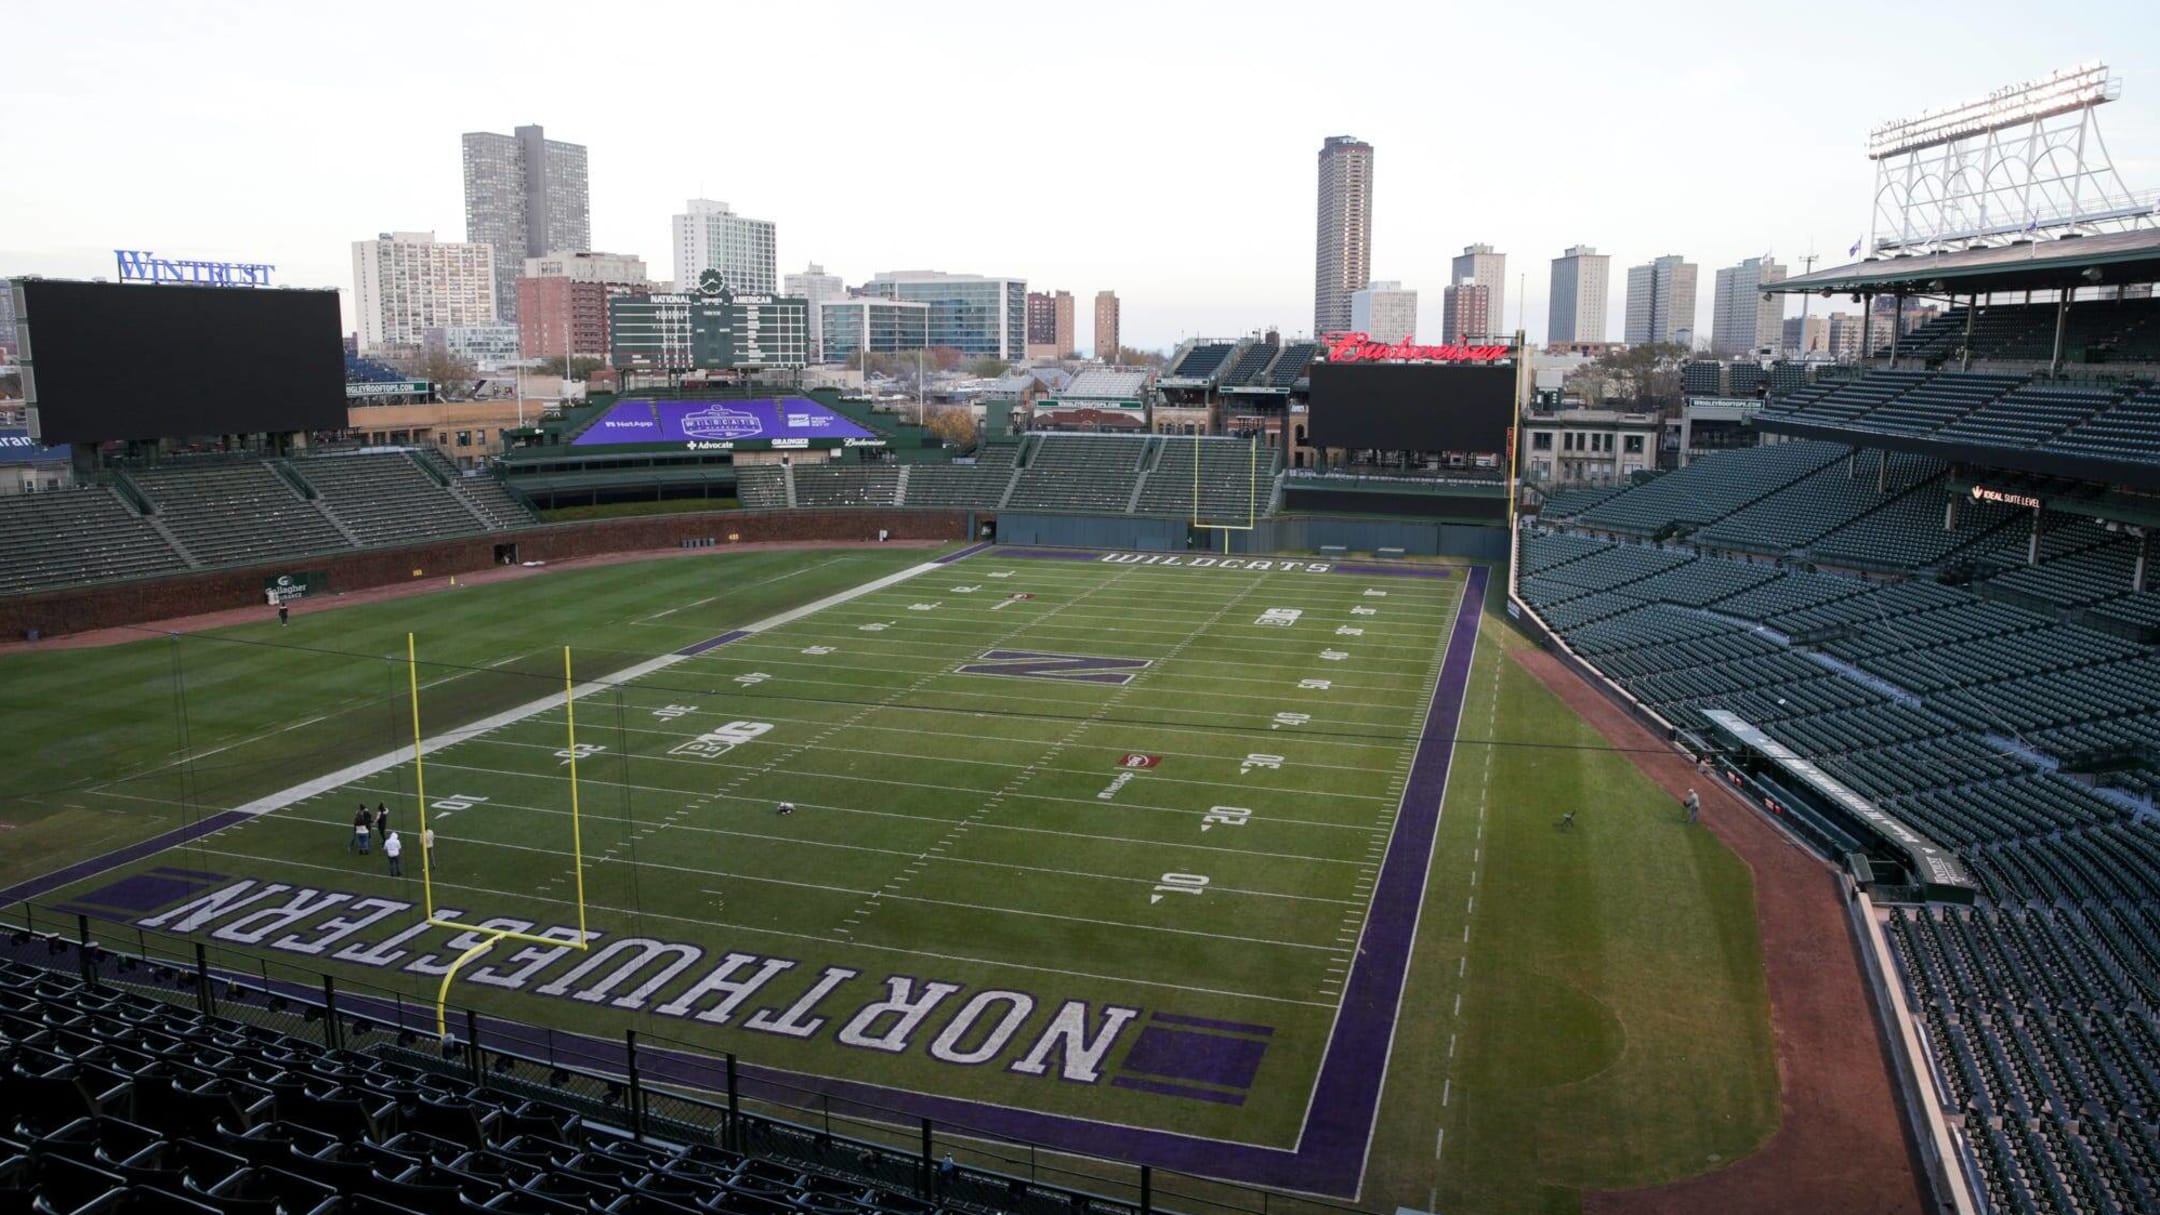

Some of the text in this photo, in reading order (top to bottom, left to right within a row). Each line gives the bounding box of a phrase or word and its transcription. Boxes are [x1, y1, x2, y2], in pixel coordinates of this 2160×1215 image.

[650, 294, 692, 304] NATIONAL
[732, 295, 772, 304] AMERICAN
[1321, 331, 1508, 362] Budweiser
[698, 441, 734, 449] Advocate
[1983, 490, 2004, 502] IDEAL
[2022, 497, 2040, 508] LEVEL
[1101, 553, 1331, 573] WILDCATS
[1153, 872, 1210, 896] 10
[134, 878, 1142, 1085] NORTHWESTERN
